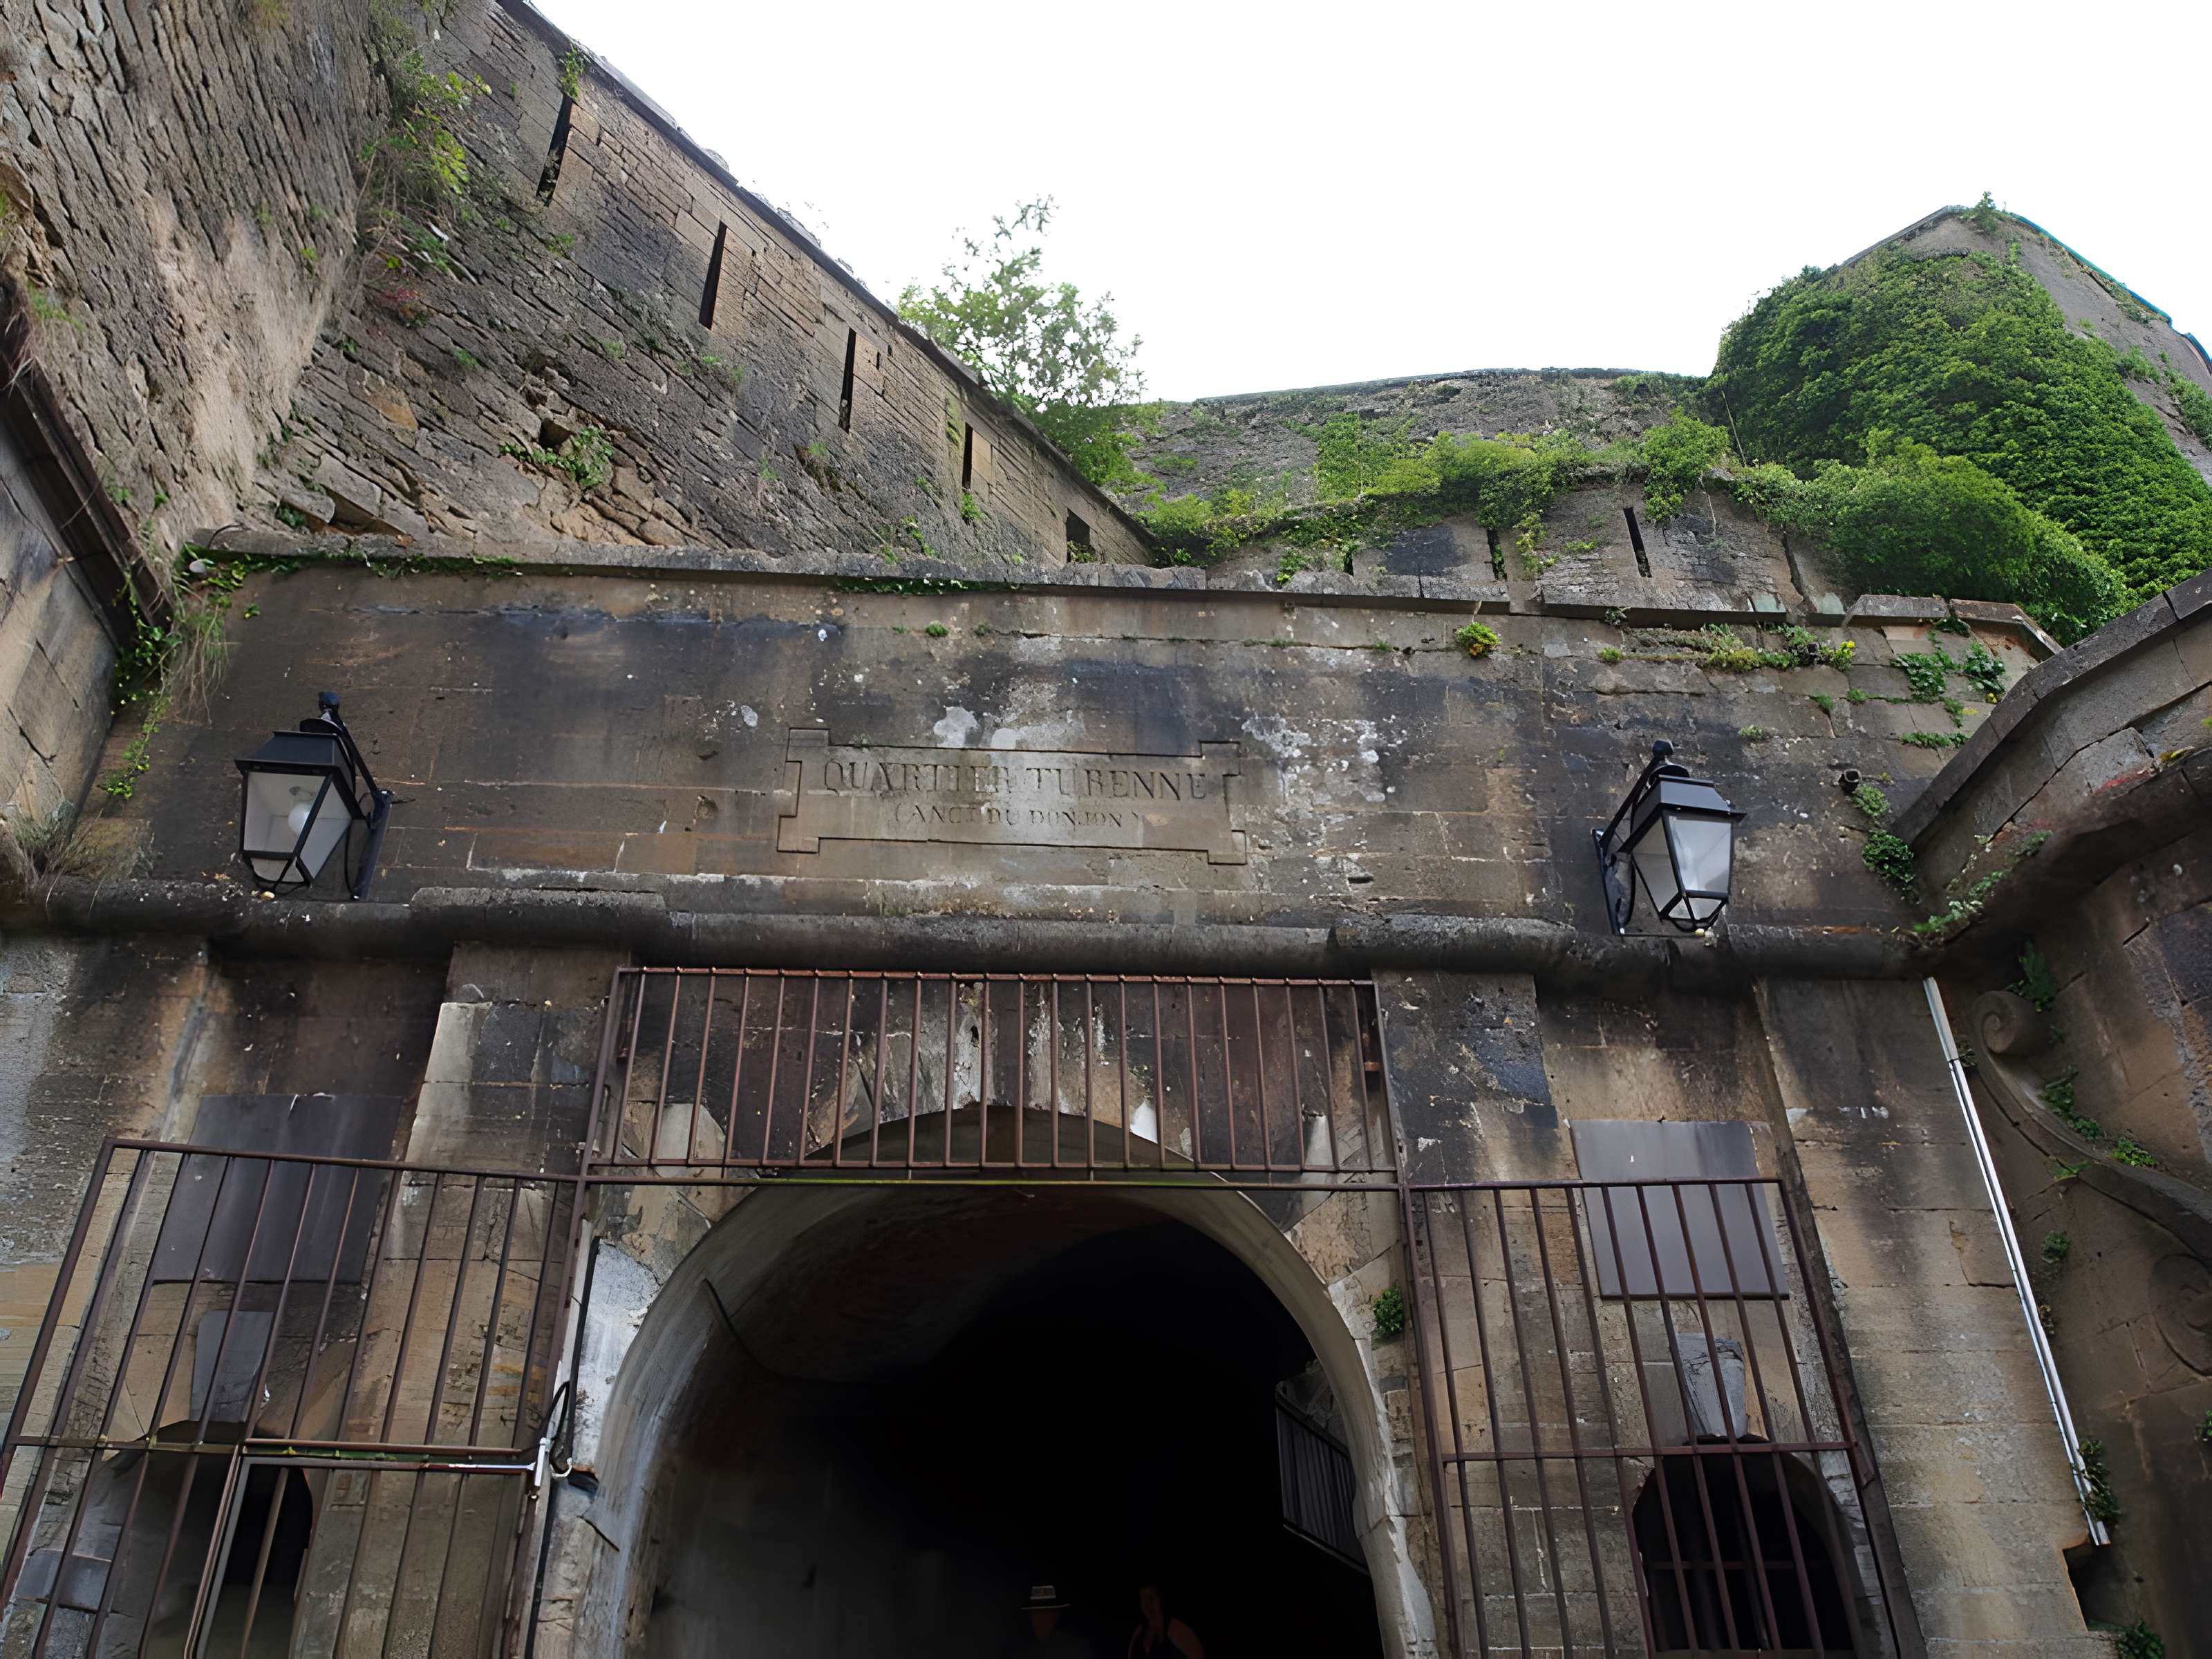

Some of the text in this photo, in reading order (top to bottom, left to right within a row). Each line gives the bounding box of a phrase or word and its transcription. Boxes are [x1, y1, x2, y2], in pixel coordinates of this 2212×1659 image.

[825, 760, 1206, 800] QUARTIER TURENNE
[987, 807, 1020, 825] DU
